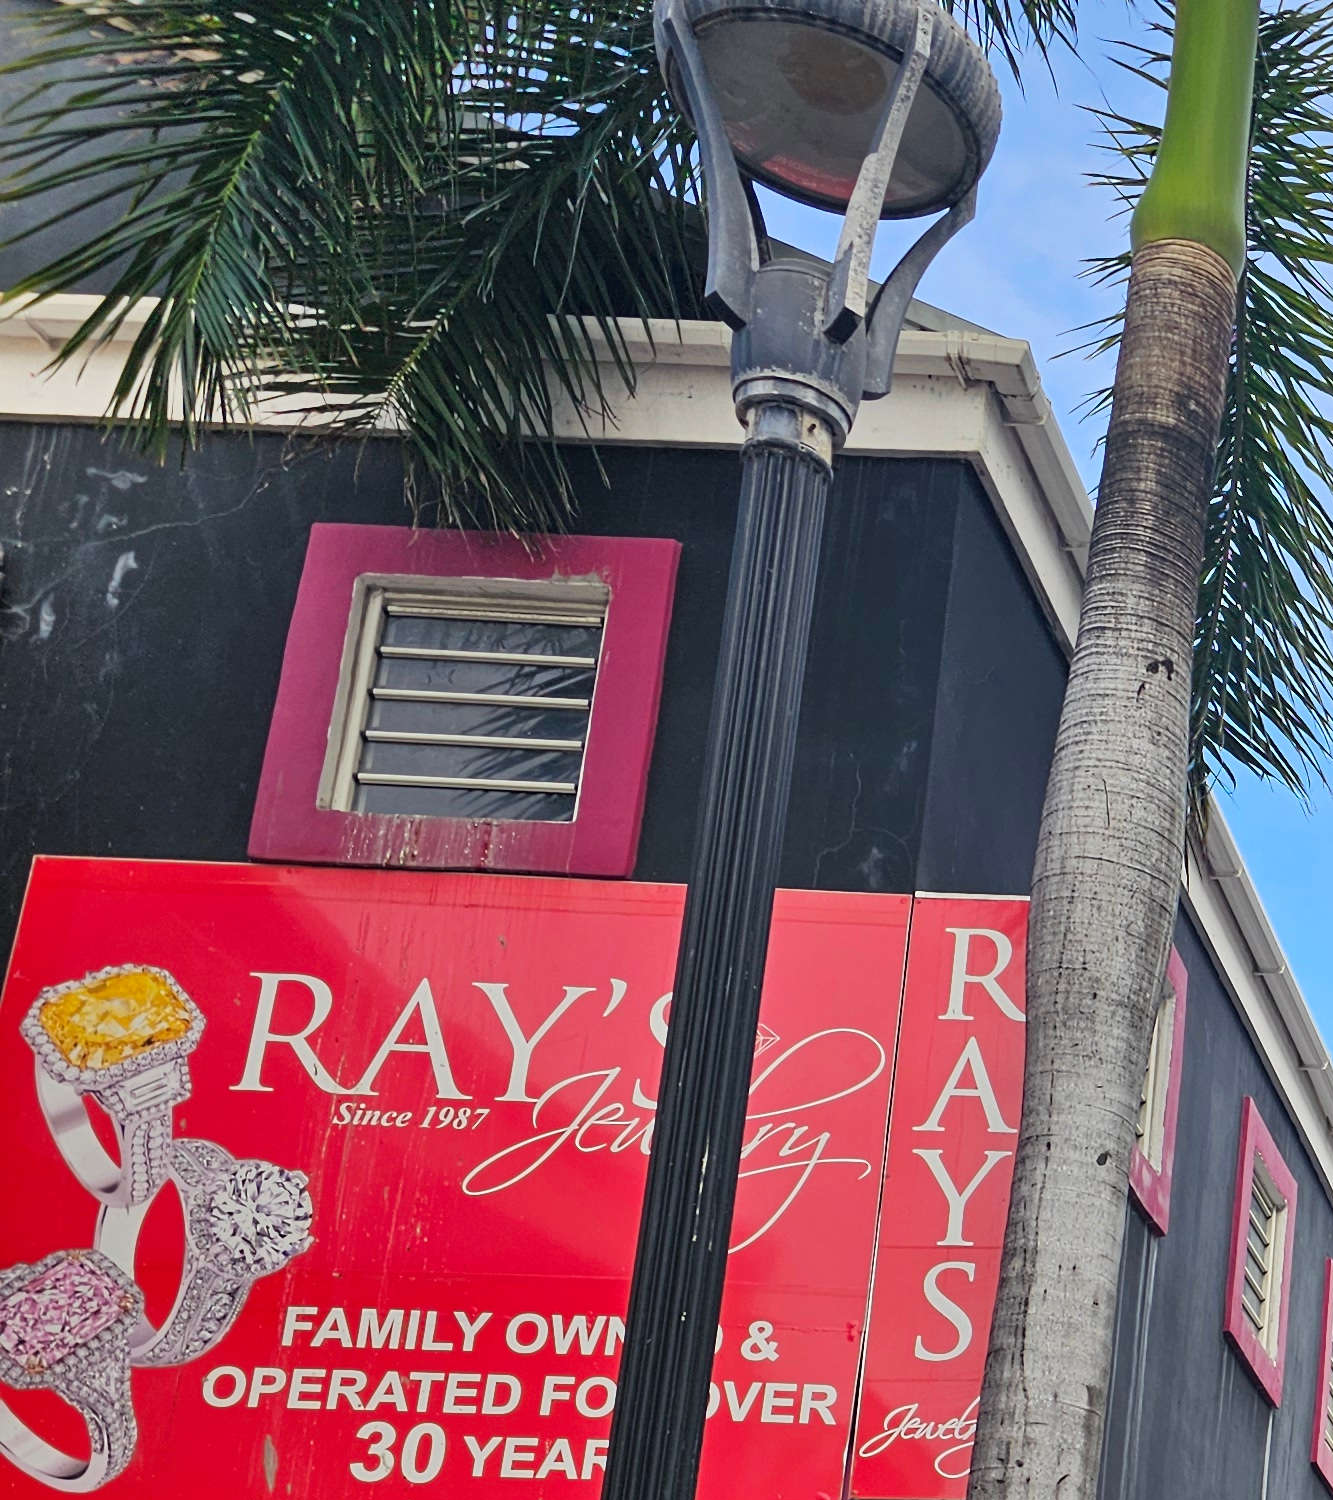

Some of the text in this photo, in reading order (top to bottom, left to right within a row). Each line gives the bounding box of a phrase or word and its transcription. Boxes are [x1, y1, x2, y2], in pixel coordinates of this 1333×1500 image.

[332, 1101, 491, 1131] Since 1987
[912, 927, 1027, 1362] RAYS
[282, 1306, 493, 1352] FAMILY
[740, 1320, 780, 1361] &
[203, 1365, 838, 1425] OPERATED FO VER
[350, 1421, 610, 1484] 30 YEAR
